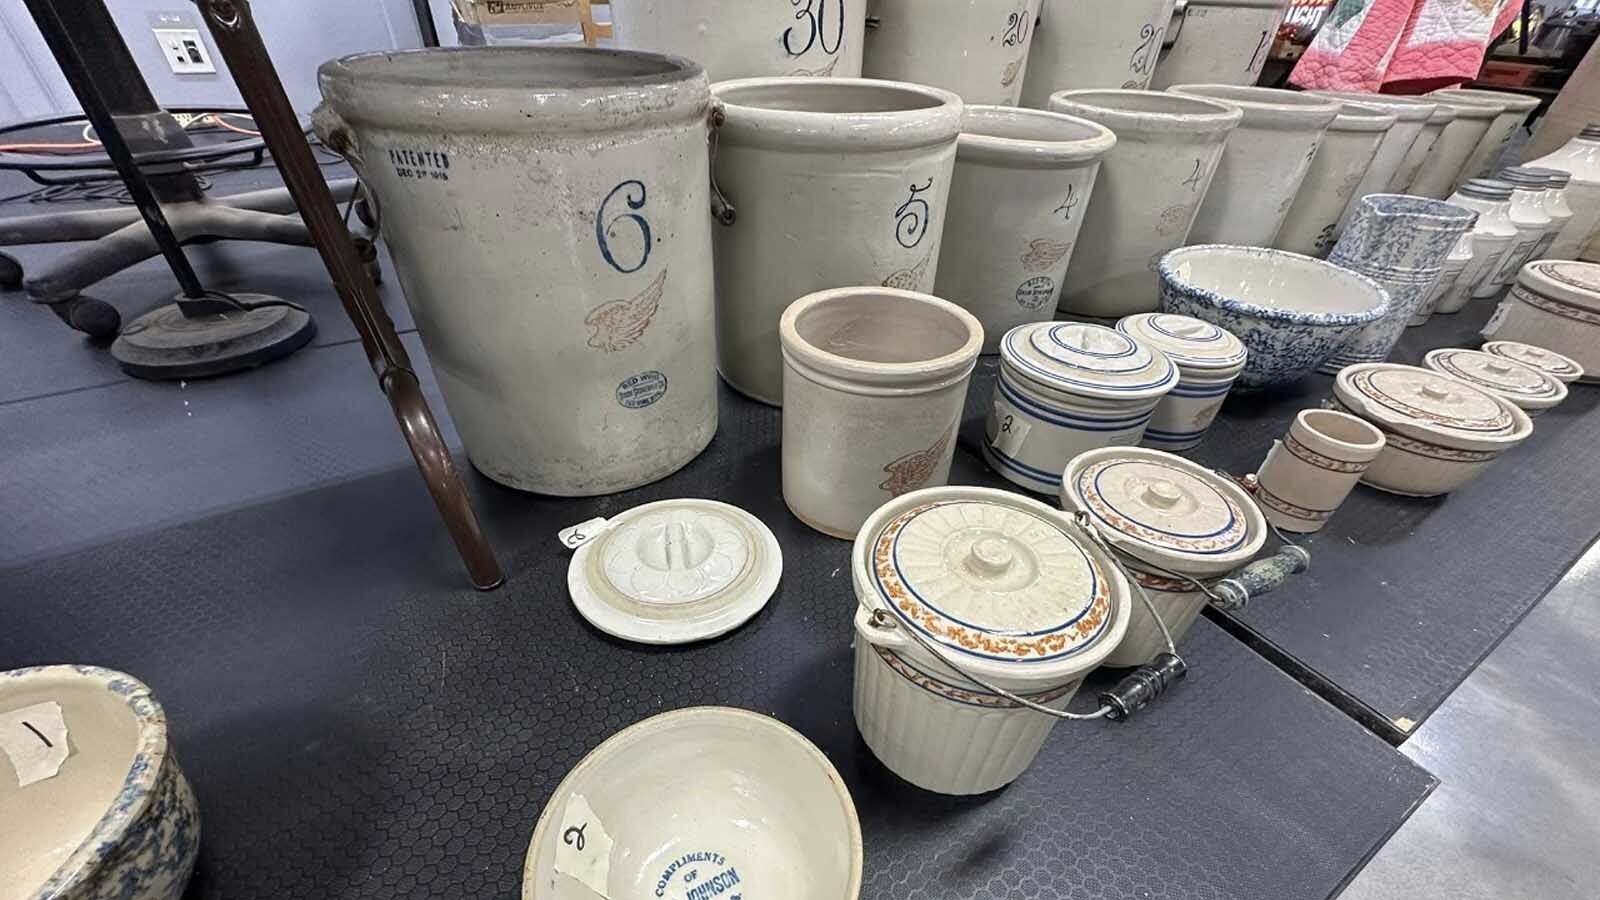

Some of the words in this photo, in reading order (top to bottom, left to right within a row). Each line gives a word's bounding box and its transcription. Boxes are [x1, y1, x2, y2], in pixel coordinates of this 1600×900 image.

[783, 0, 845, 56] 30
[1003, 10, 1029, 47] 20
[1130, 24, 1164, 75] 20
[388, 149, 450, 169] PATENTED
[1182, 158, 1203, 192] 4
[895, 177, 933, 248] 5
[1053, 184, 1079, 220] 4
[596, 180, 651, 273] 6
[1002, 414, 1013, 433] 2
[567, 528, 586, 545] 2
[21, 721, 53, 748] 1
[563, 823, 588, 851] 2
[655, 851, 726, 897] COMPLIMENTS
[683, 869, 698, 882] OF
